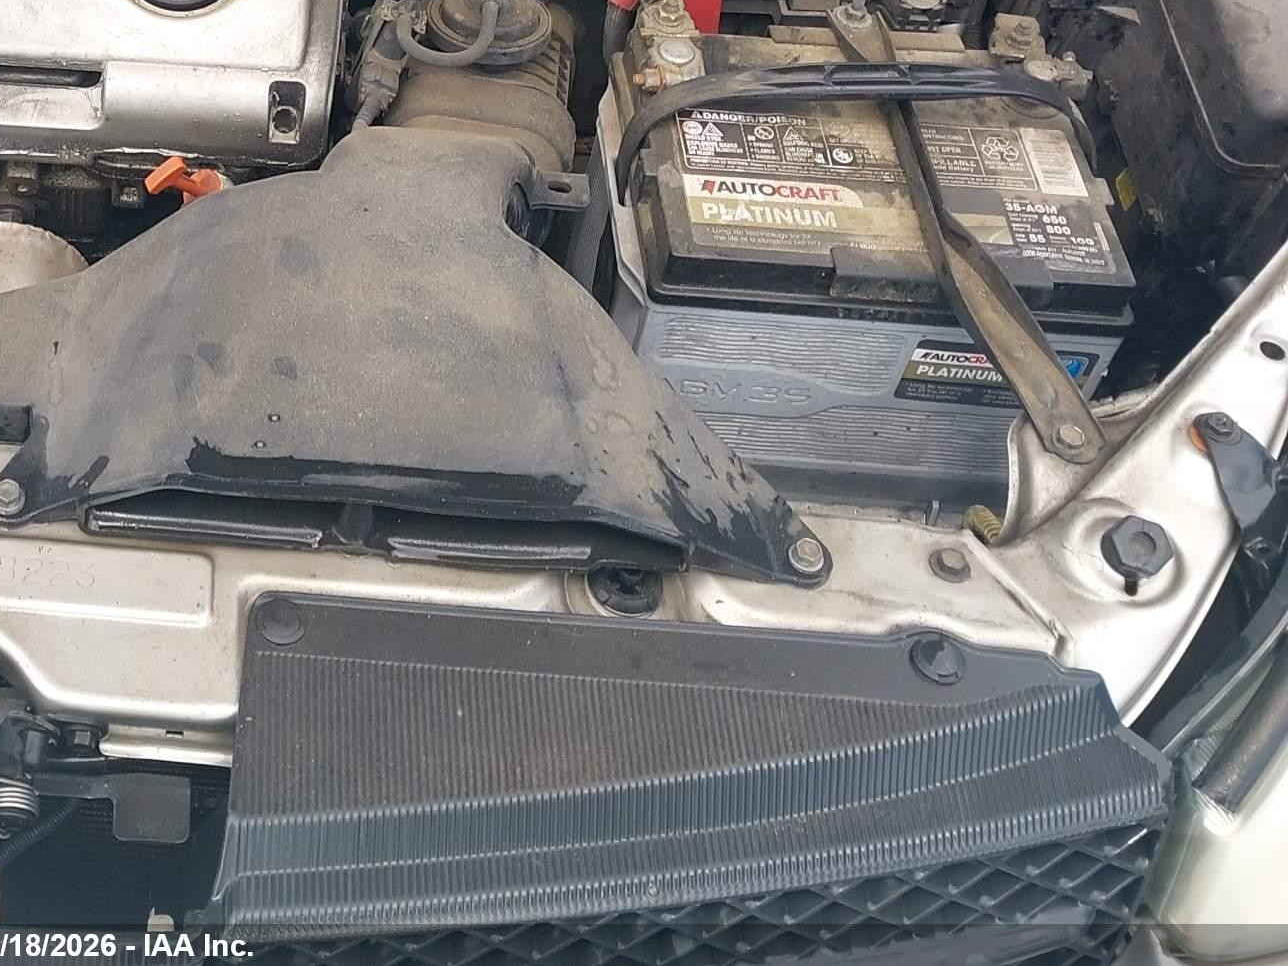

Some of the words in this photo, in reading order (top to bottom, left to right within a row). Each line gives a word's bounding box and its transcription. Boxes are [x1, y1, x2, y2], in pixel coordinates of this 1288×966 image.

[703, 112, 806, 126] DANGER/POISON
[941, 146, 962, 154] OPEN
[717, 180, 839, 201] AUTOCRAFT
[1004, 203, 1057, 214] 35-AGM
[702, 202, 837, 227] PLATINUM
[1042, 215, 1067, 224] 650
[712, 227, 731, 235] Long
[1029, 234, 1046, 244] 55
[916, 364, 1002, 382] PLATINUM
